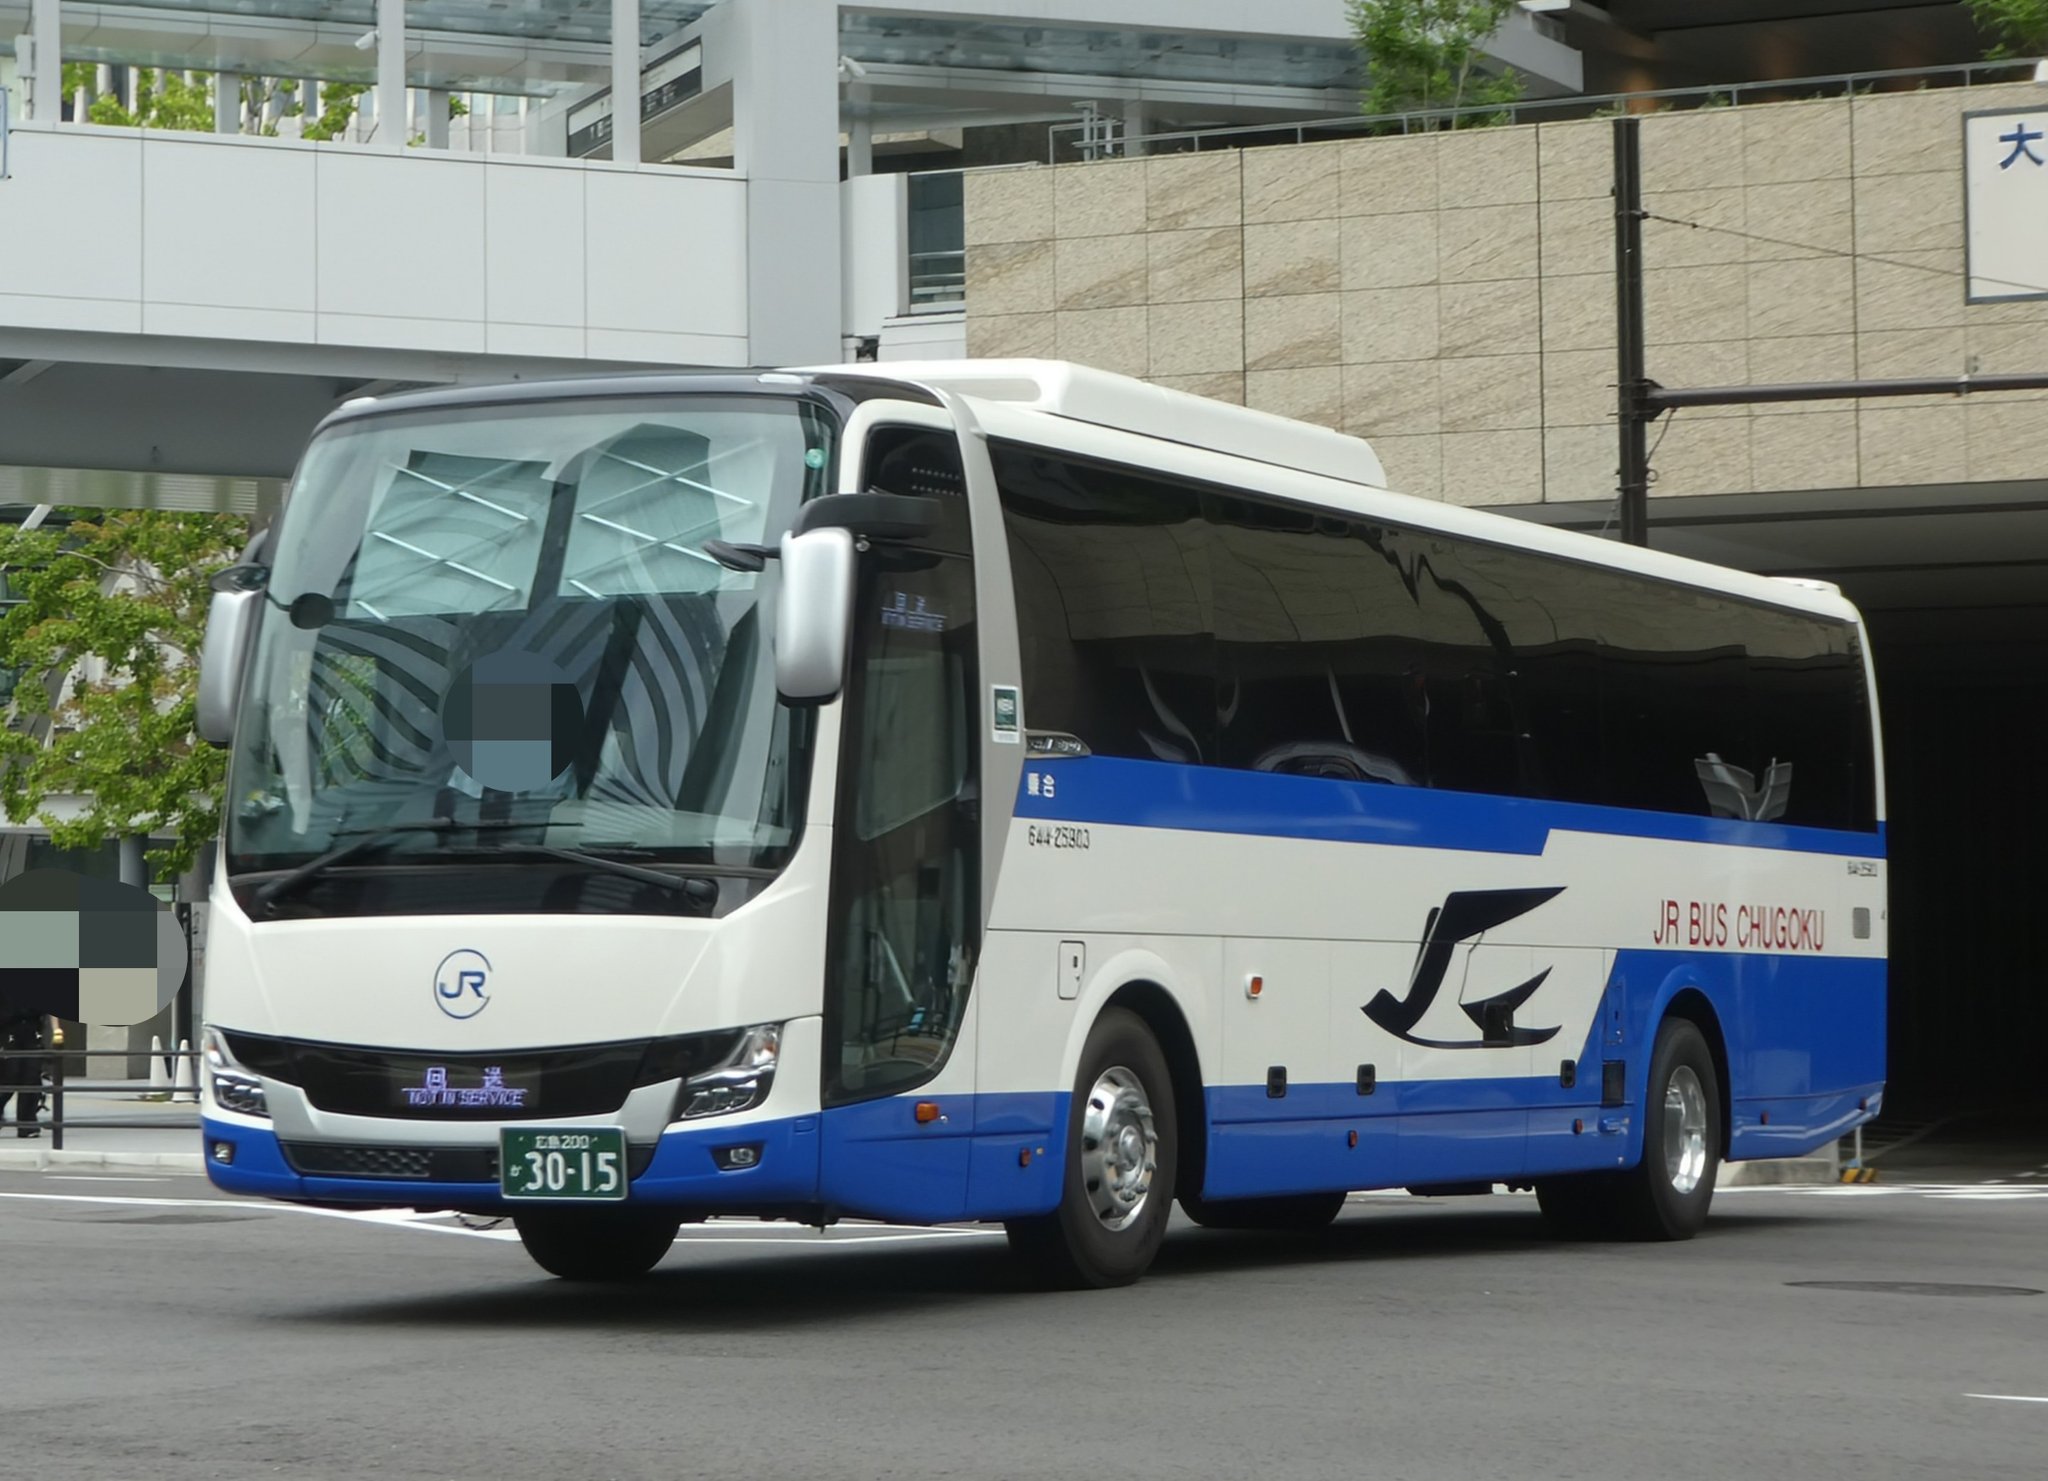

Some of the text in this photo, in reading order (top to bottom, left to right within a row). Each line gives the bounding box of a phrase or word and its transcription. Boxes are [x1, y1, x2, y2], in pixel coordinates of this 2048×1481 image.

[1999, 122, 2044, 170] 大
[1653, 899, 1825, 951] JR BUS CHUGOKU
[439, 970, 486, 999] JR
[459, 1090, 524, 1106] SERVICE
[525, 1151, 618, 1192] 30-15
